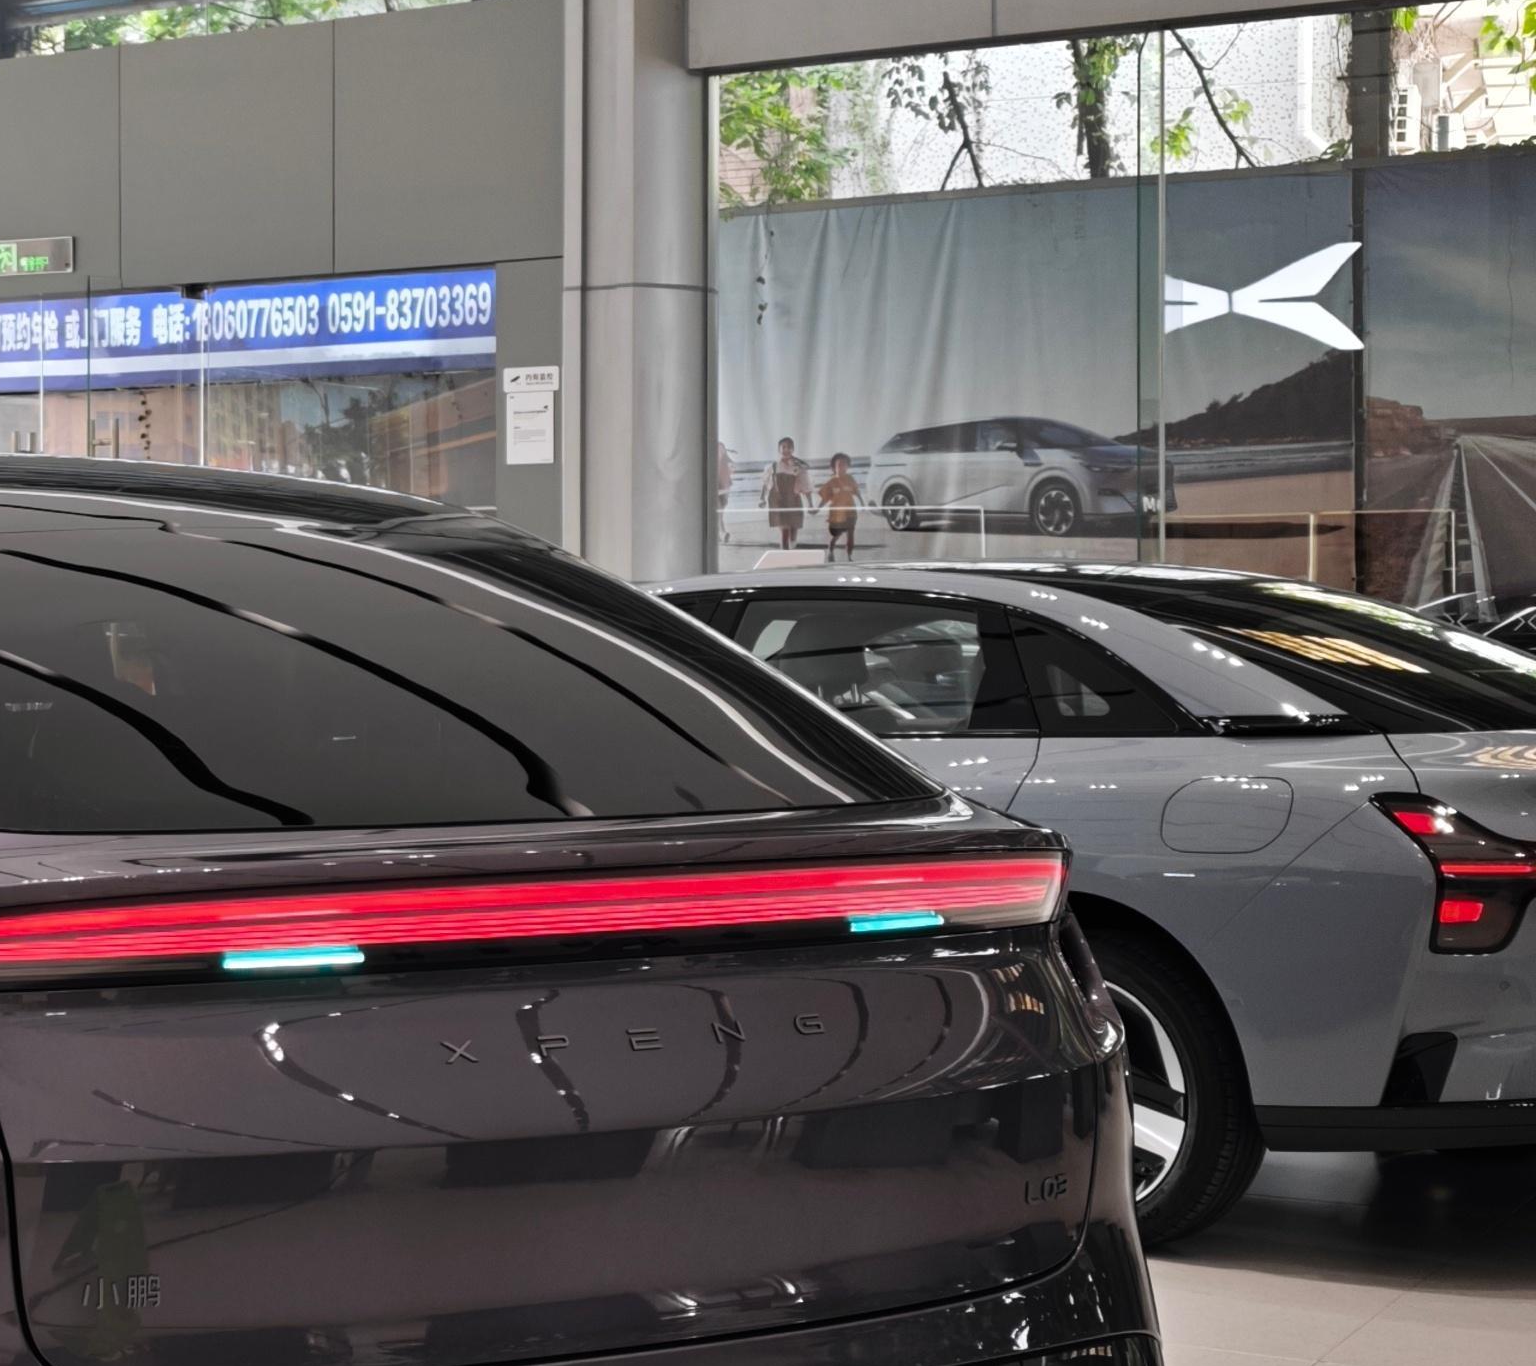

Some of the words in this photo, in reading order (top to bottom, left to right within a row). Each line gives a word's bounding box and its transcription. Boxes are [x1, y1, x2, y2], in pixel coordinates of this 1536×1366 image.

[328, 282, 492, 333] 0591-83703369
[440, 1014, 825, 1065] XPENG
[82, 1275, 161, 1310] 小鹏
